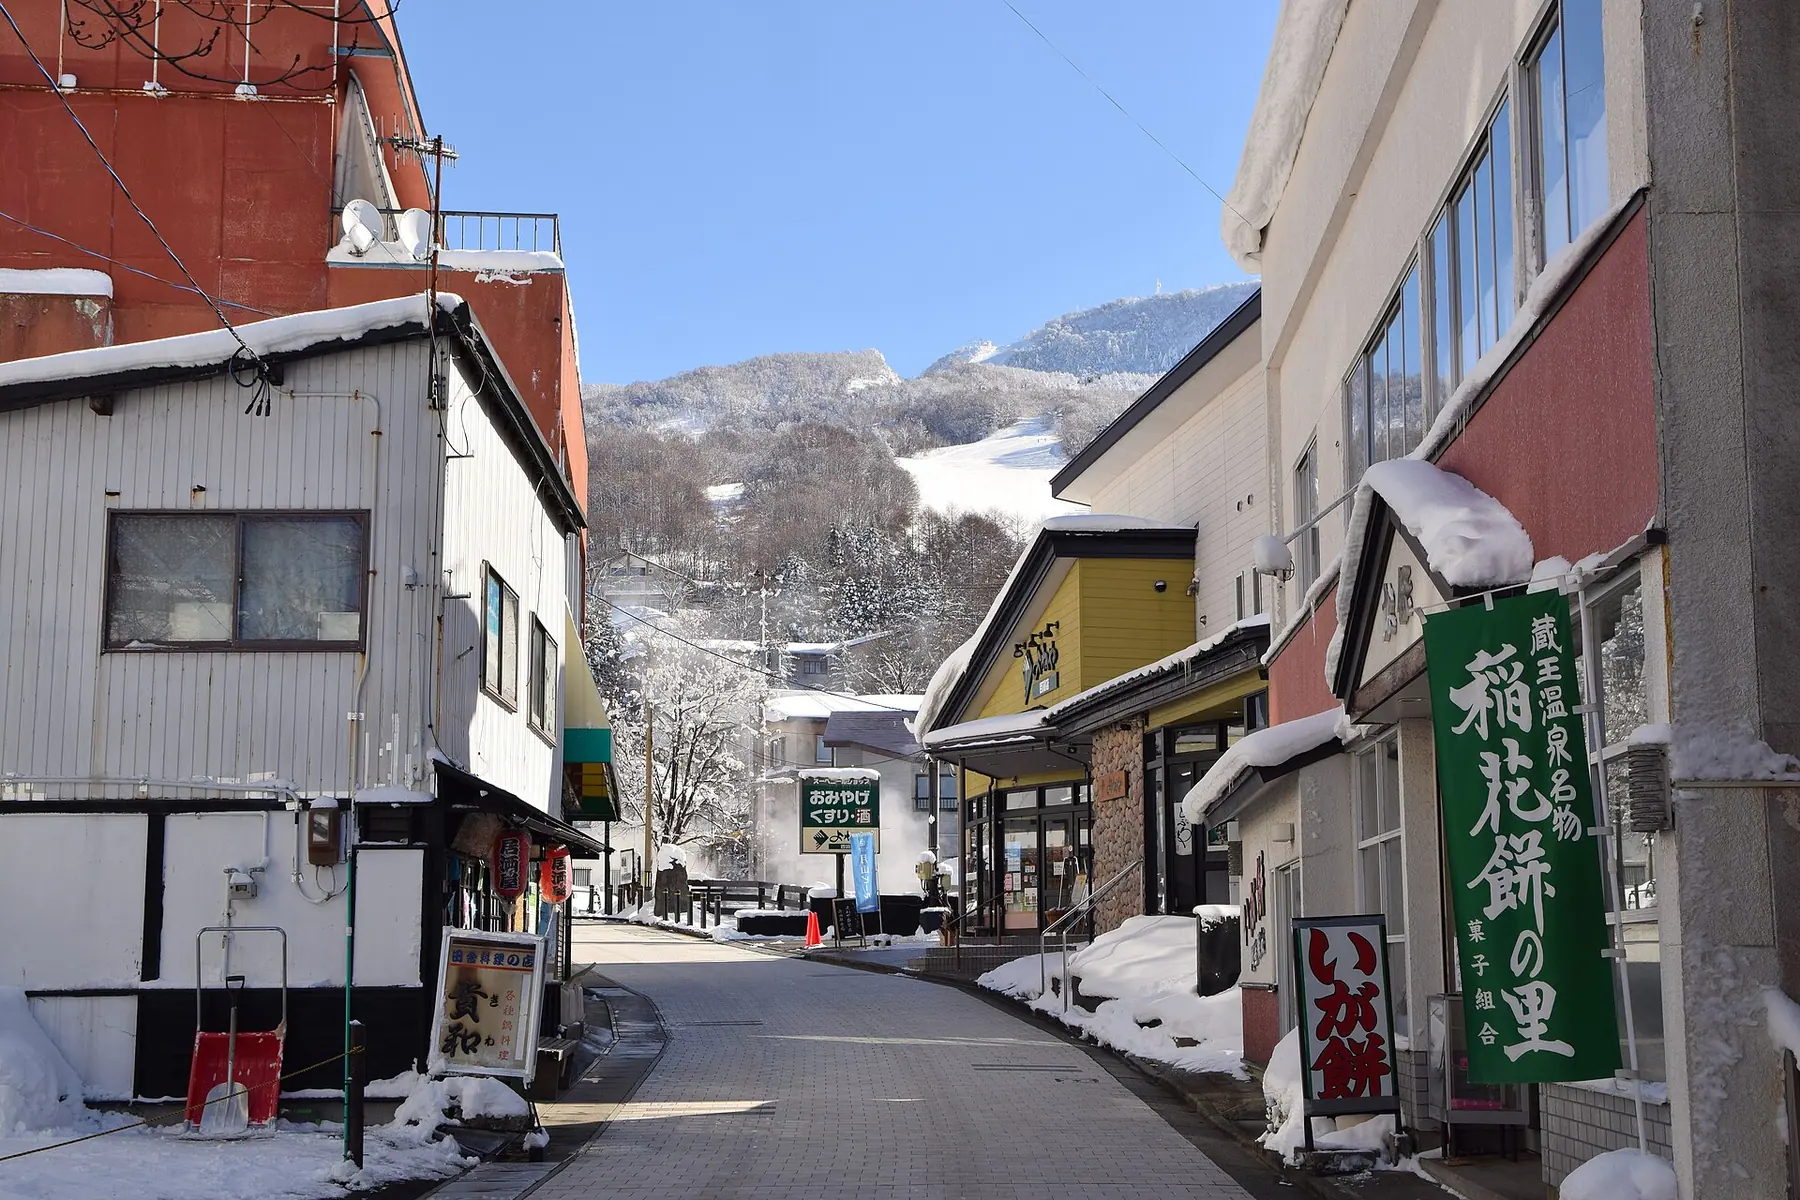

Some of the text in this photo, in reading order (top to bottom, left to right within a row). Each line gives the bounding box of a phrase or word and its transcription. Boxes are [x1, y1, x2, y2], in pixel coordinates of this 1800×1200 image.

[1530, 613, 1582, 841] 蔵王温泉名物
[809, 790, 870, 805] おみやげ
[810, 809, 871, 823] くすり・酒
[499, 838, 519, 889] 居酒屋
[551, 857, 567, 897] 居酒屋
[1450, 644, 1575, 1062] 稲花餅の里
[451, 949, 535, 968] 田舎料理の店
[1467, 919, 1499, 1046] 菓子組合
[441, 978, 488, 1058] 貴和
[498, 990, 515, 1061] 各種鍋料理
[1309, 927, 1391, 1099] いが餅
